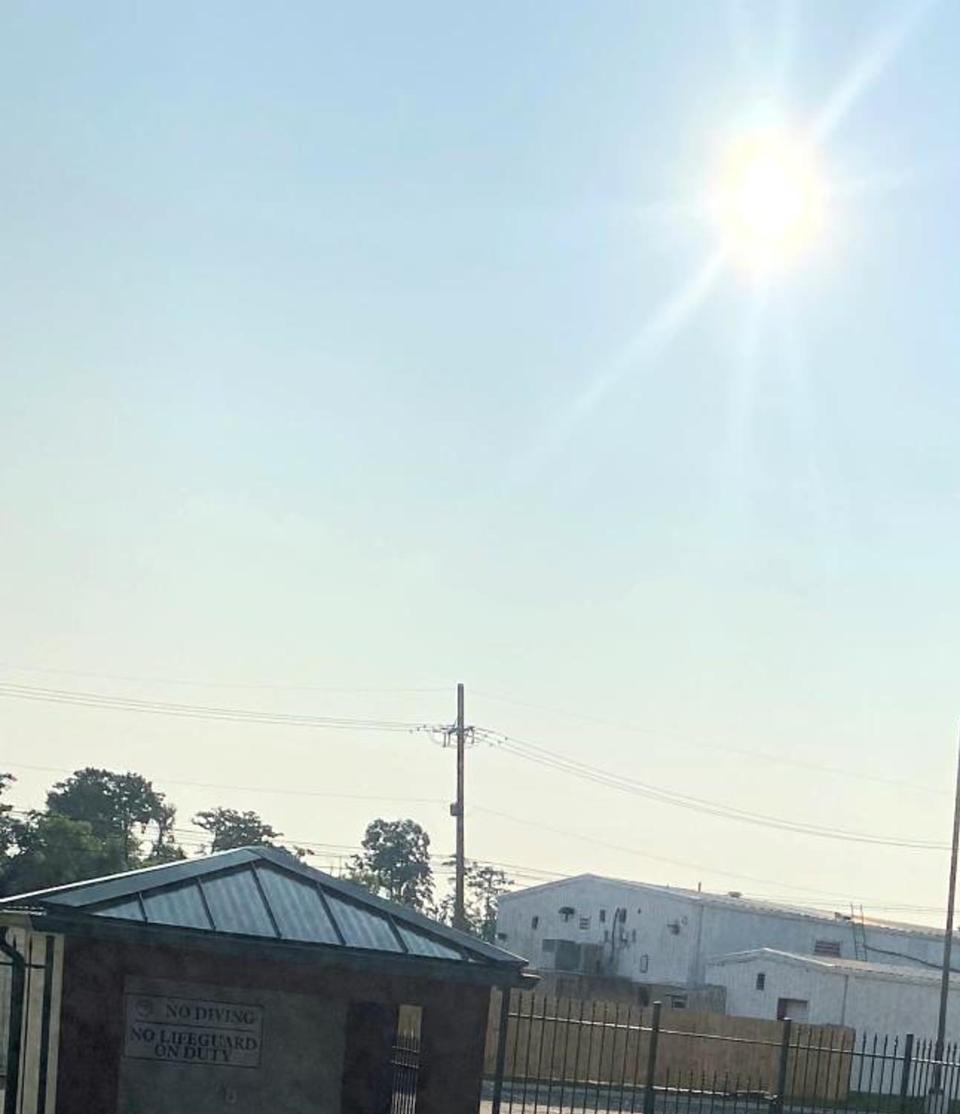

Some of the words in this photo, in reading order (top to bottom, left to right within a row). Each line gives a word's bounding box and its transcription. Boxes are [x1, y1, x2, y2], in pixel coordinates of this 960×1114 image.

[166, 1003, 191, 1018] NO
[194, 1006, 256, 1025] DIVING
[130, 1026, 155, 1042] NO
[159, 1030, 258, 1050] LIFEGUARD
[155, 1044, 178, 1058] ON
[183, 1047, 233, 1063] DUTY
